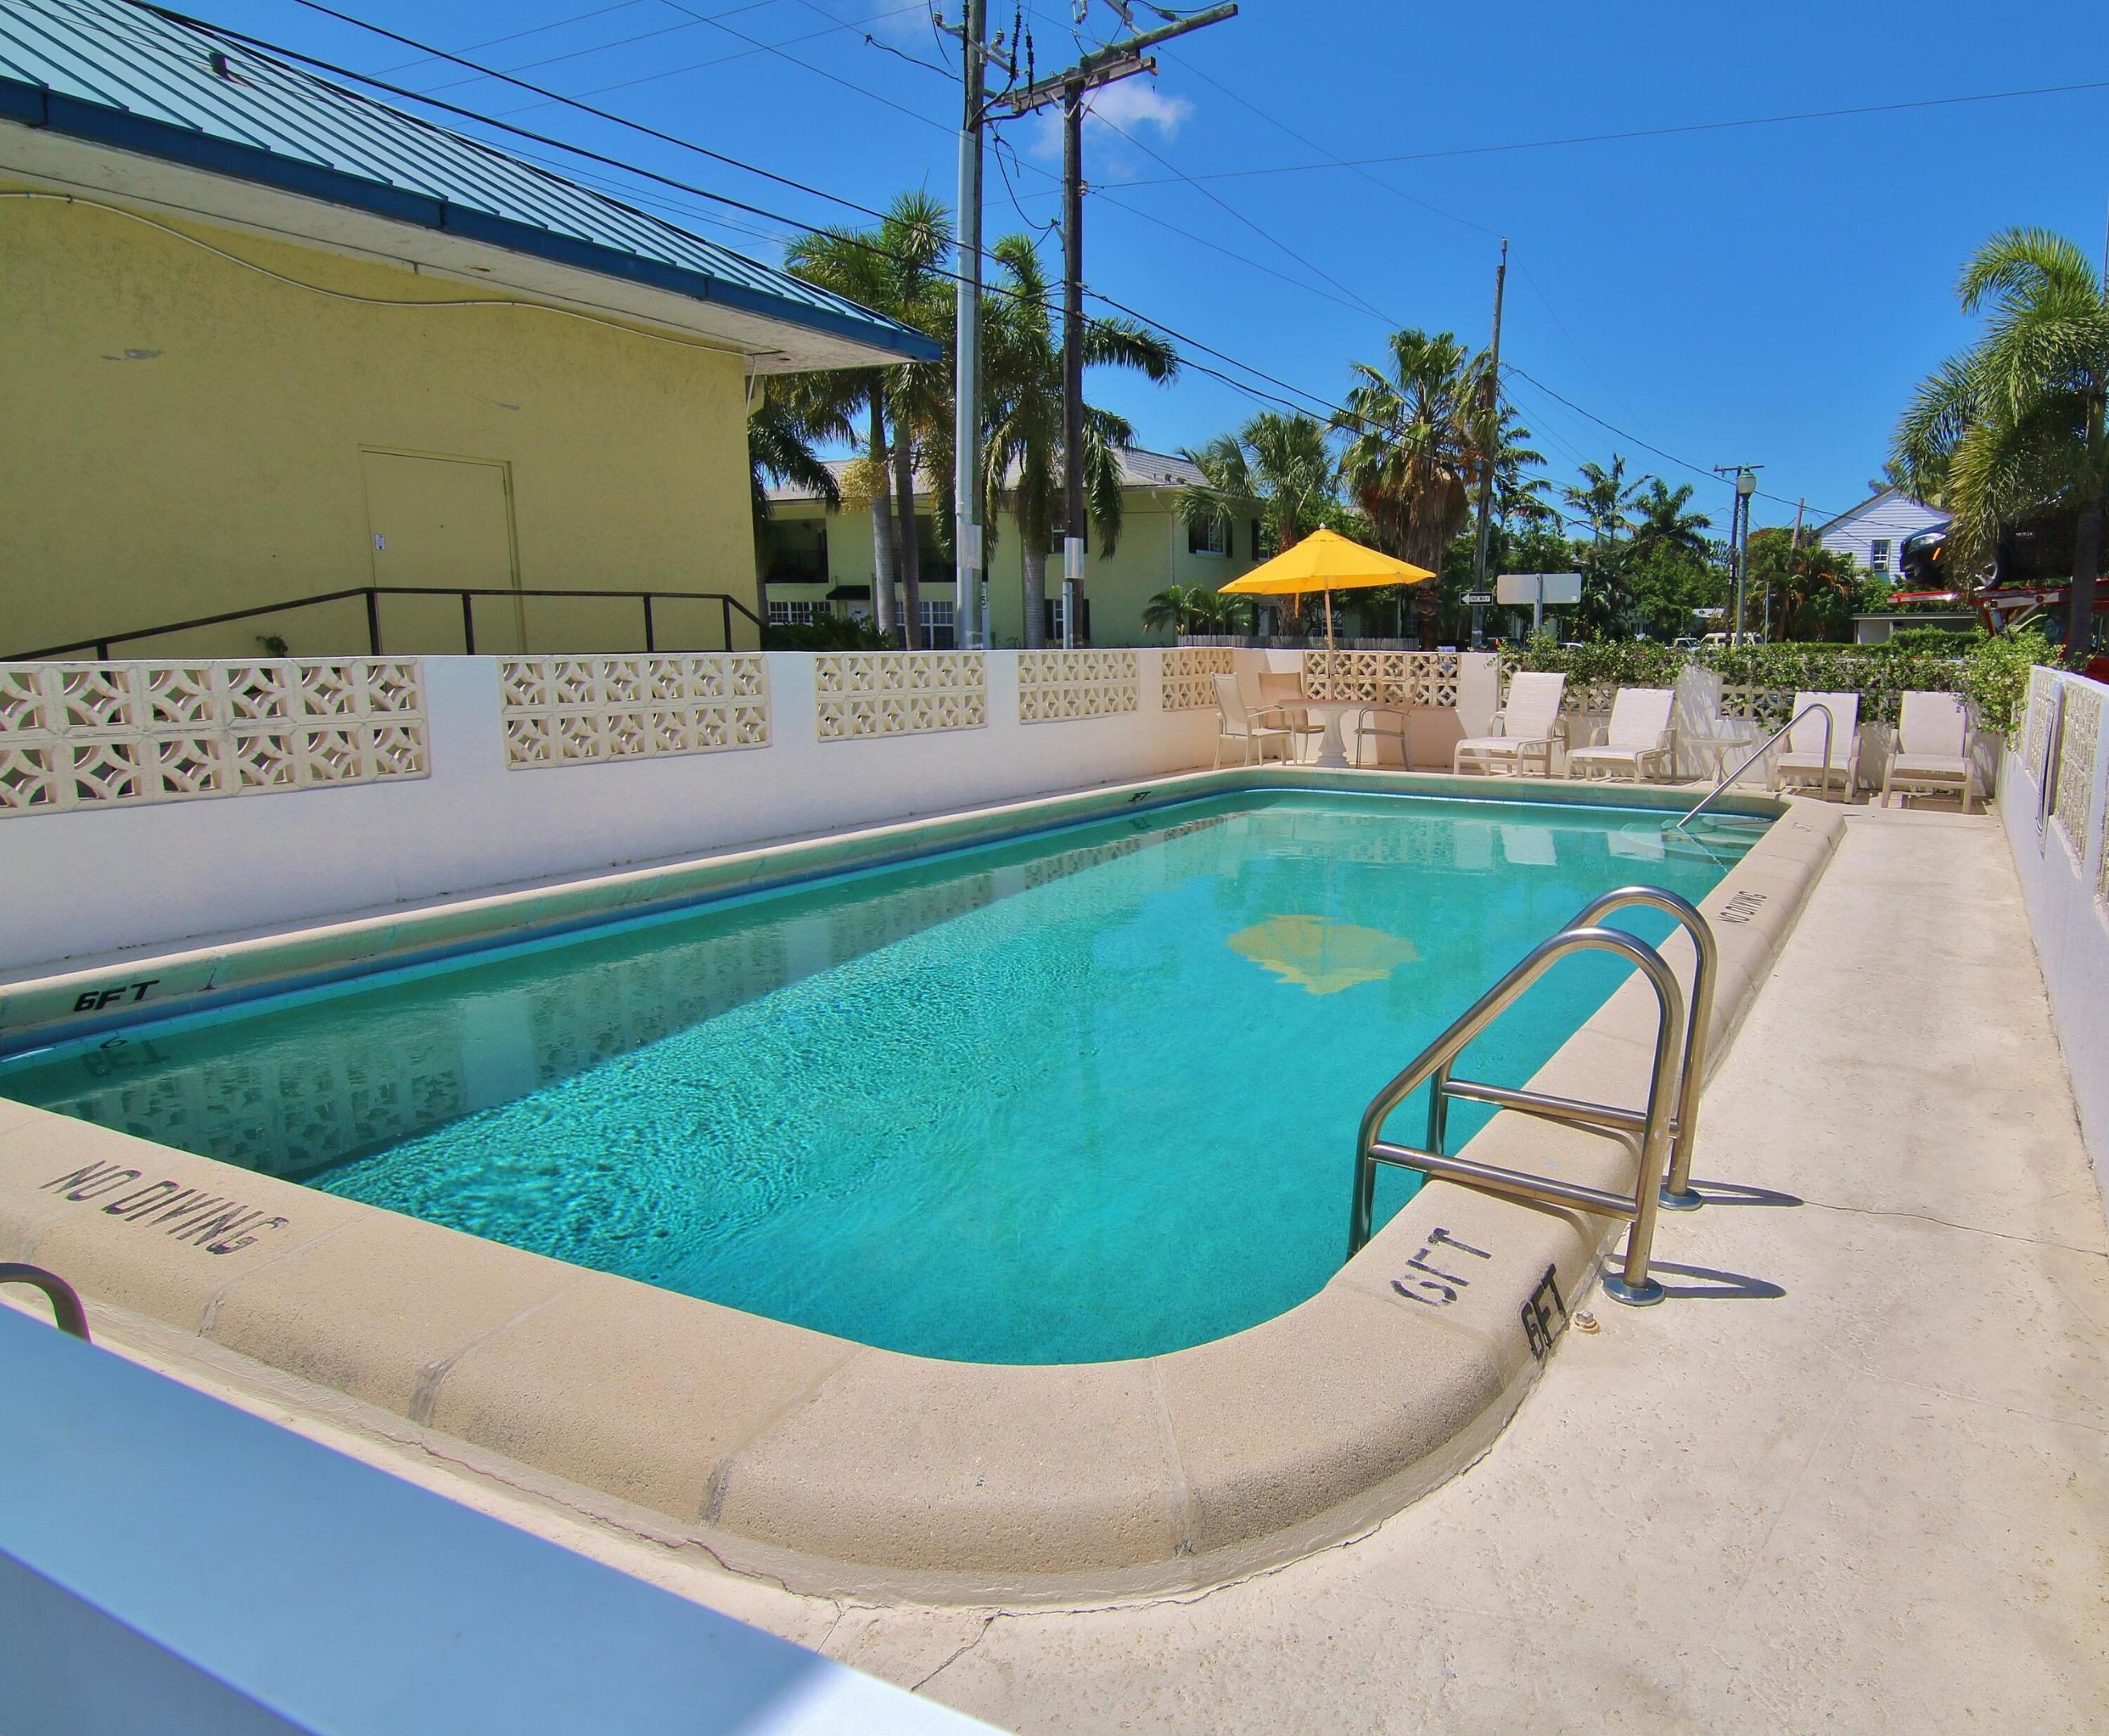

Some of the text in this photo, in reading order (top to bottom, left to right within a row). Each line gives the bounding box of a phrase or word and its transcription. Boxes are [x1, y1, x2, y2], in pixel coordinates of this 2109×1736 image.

[1717, 891, 1767, 924] NO DIVING
[73, 979, 160, 1013] 6FT
[39, 1160, 290, 1255] NO DIVING
[1520, 1263, 1568, 1363] 6FT
